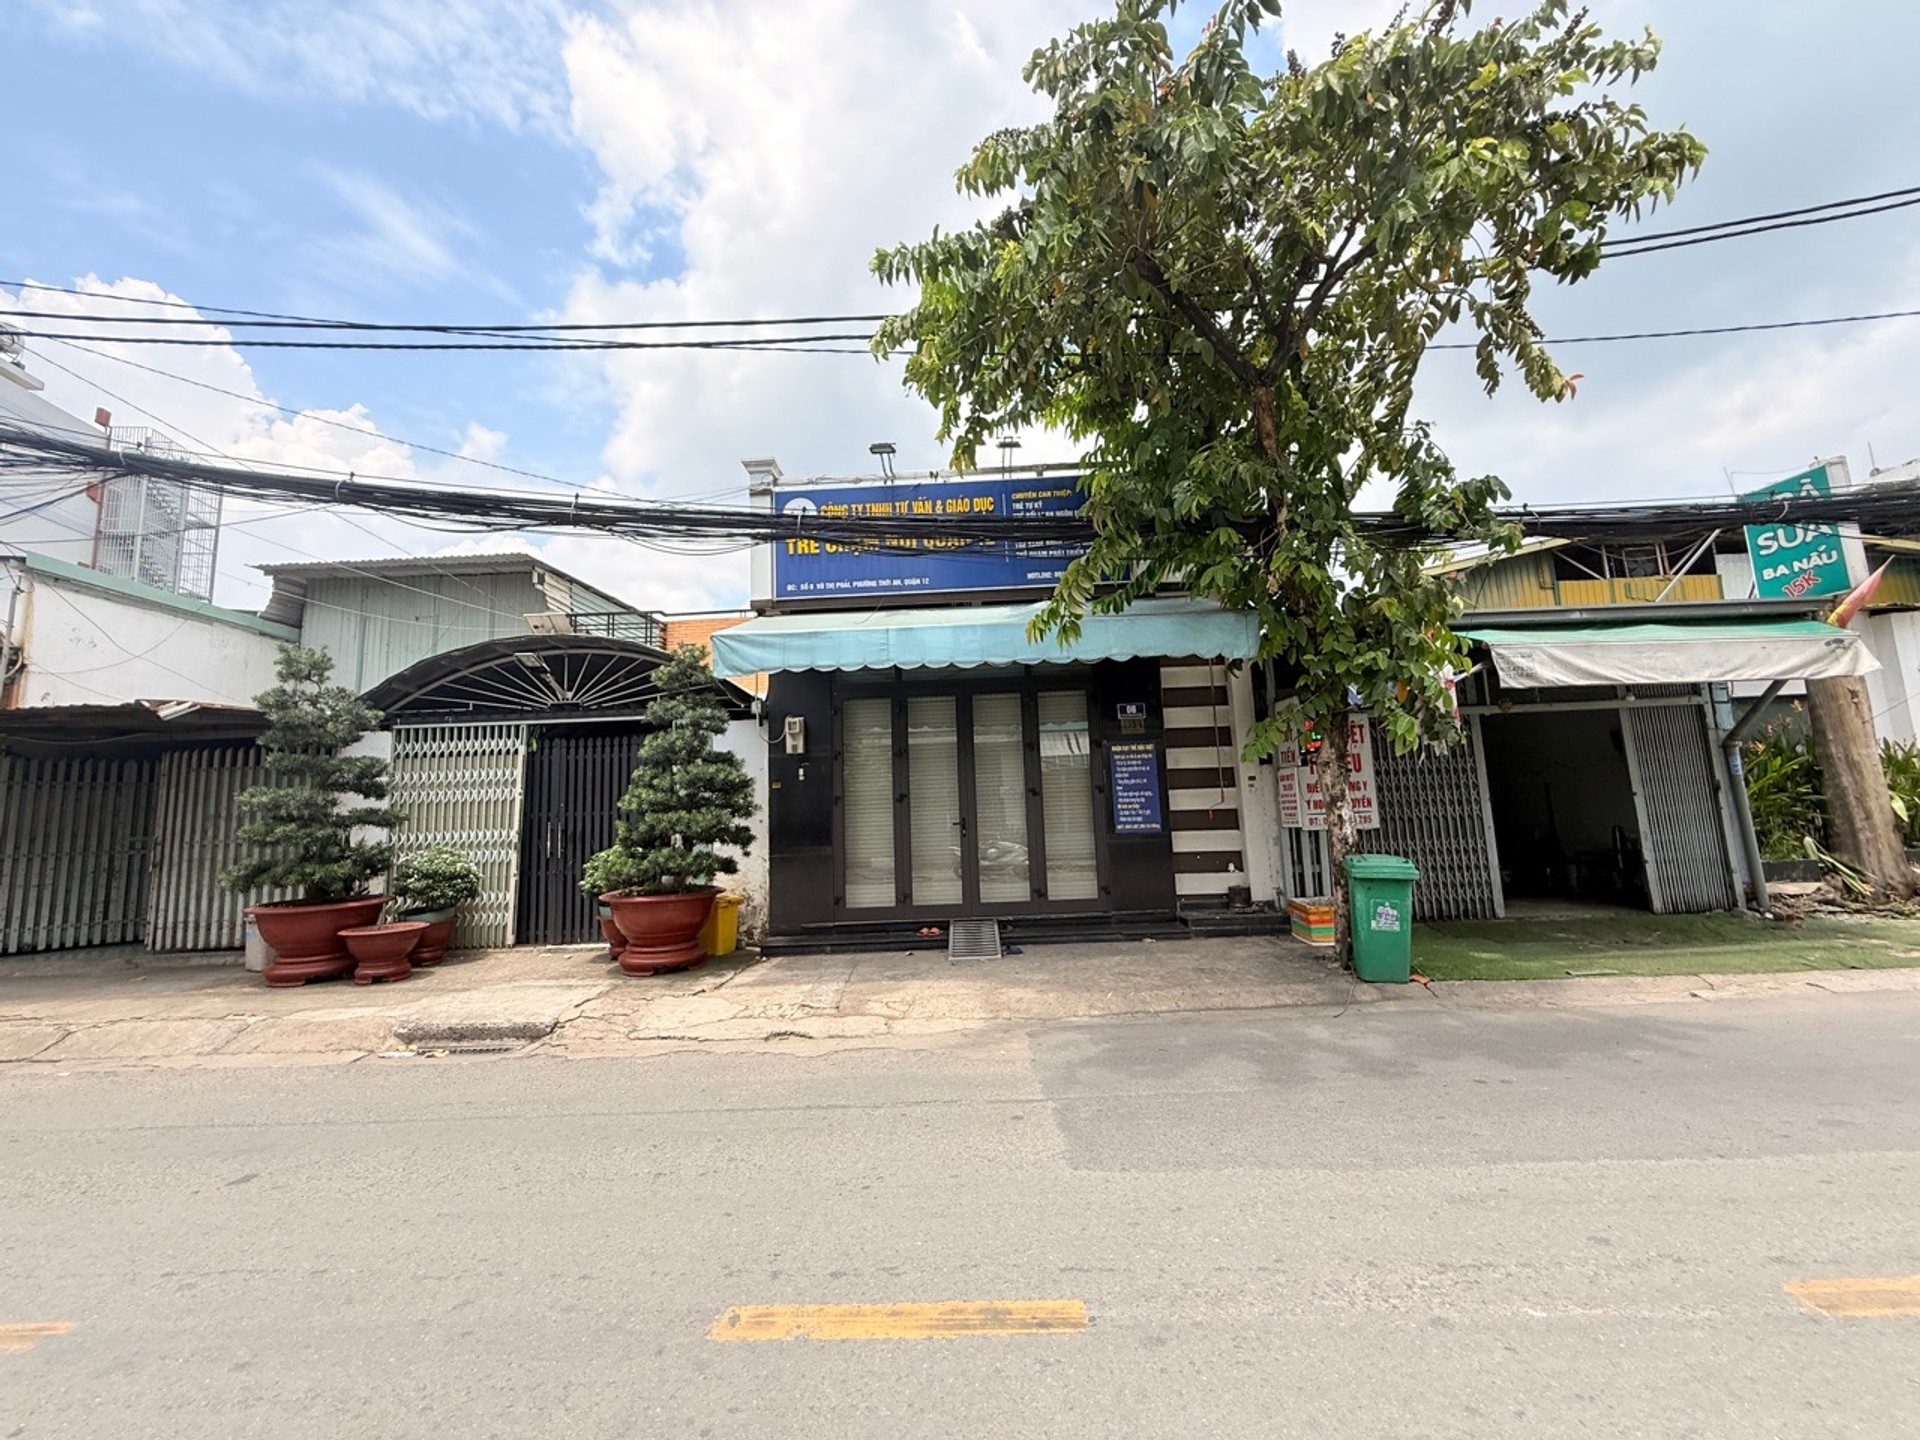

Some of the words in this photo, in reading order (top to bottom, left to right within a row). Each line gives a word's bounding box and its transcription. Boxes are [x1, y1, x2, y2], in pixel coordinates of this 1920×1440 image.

[820, 501, 848, 517] CÔNG
[850, 503, 864, 516] TY
[865, 502, 892, 516] TNHH
[935, 499, 944, 514] &
[946, 494, 971, 513] GIÁO
[973, 496, 995, 515] DỤC
[1762, 563, 1790, 580] BA
[1792, 544, 1838, 573] NẤU
[922, 577, 930, 585] 12
[1782, 570, 1821, 597] 15K
